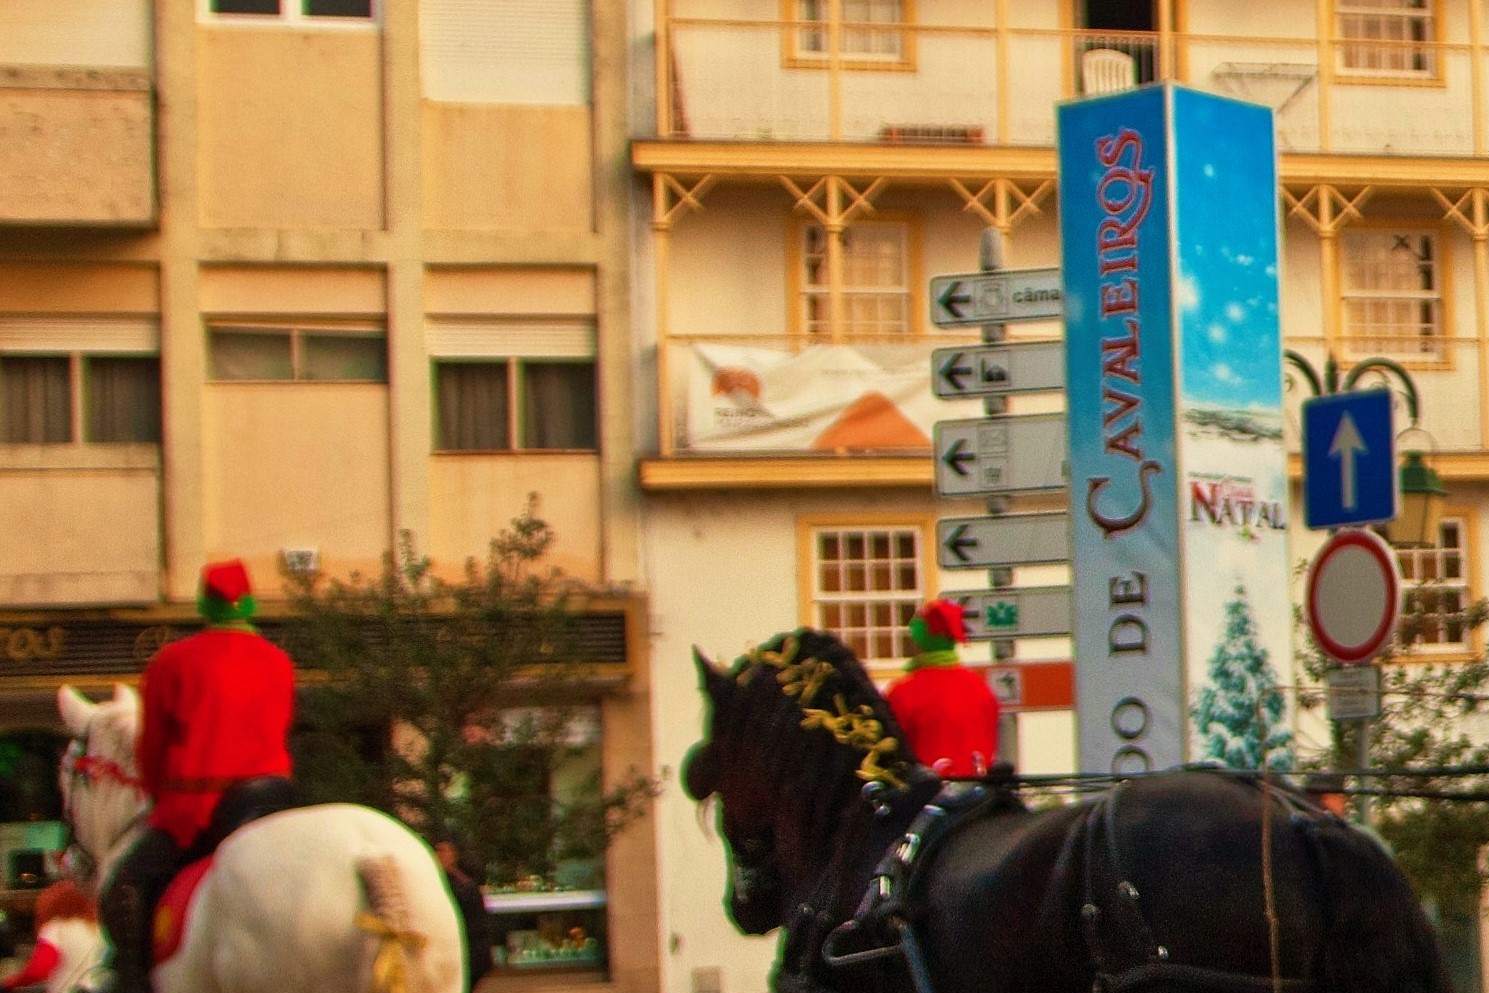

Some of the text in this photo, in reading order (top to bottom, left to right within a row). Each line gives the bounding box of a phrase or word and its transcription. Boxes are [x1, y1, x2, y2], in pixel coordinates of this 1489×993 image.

[1086, 127, 1164, 540] CAVALEIROS
[1189, 480, 1287, 530] NATAL
[1108, 571, 1150, 657] DE
